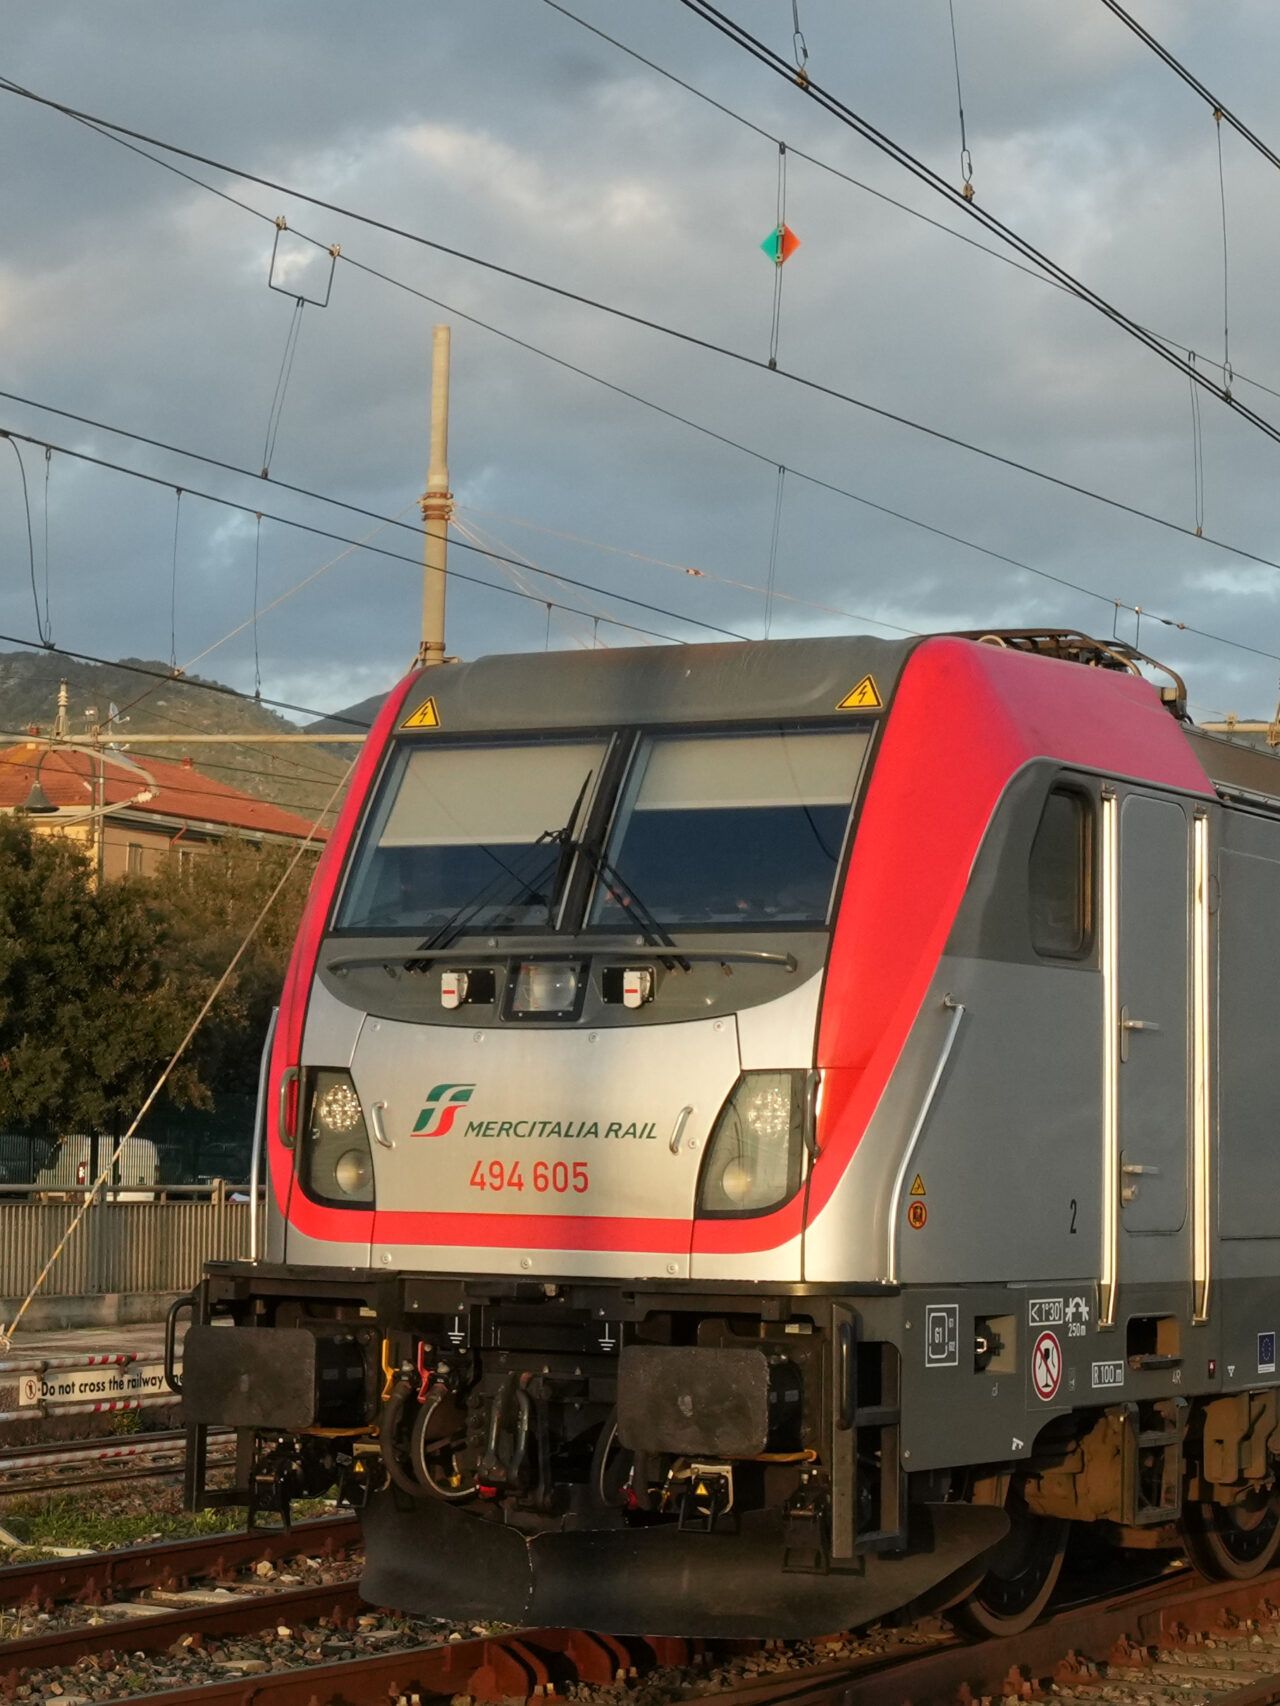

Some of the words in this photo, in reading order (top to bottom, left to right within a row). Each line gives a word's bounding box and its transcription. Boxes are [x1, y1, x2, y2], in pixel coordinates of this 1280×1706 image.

[463, 1121, 599, 1138] MERCITALIA
[604, 1122, 658, 1139] RAIL
[469, 1160, 524, 1191] 494
[532, 1161, 589, 1193] 605
[1069, 1199, 1077, 1233] 2
[41, 1380, 56, 1397] Do
[58, 1381, 75, 1396] not
[78, 1380, 106, 1394] cross
[108, 1375, 125, 1391] the
[127, 1373, 164, 1390] railway
[1101, 1365, 1115, 1384] 100
